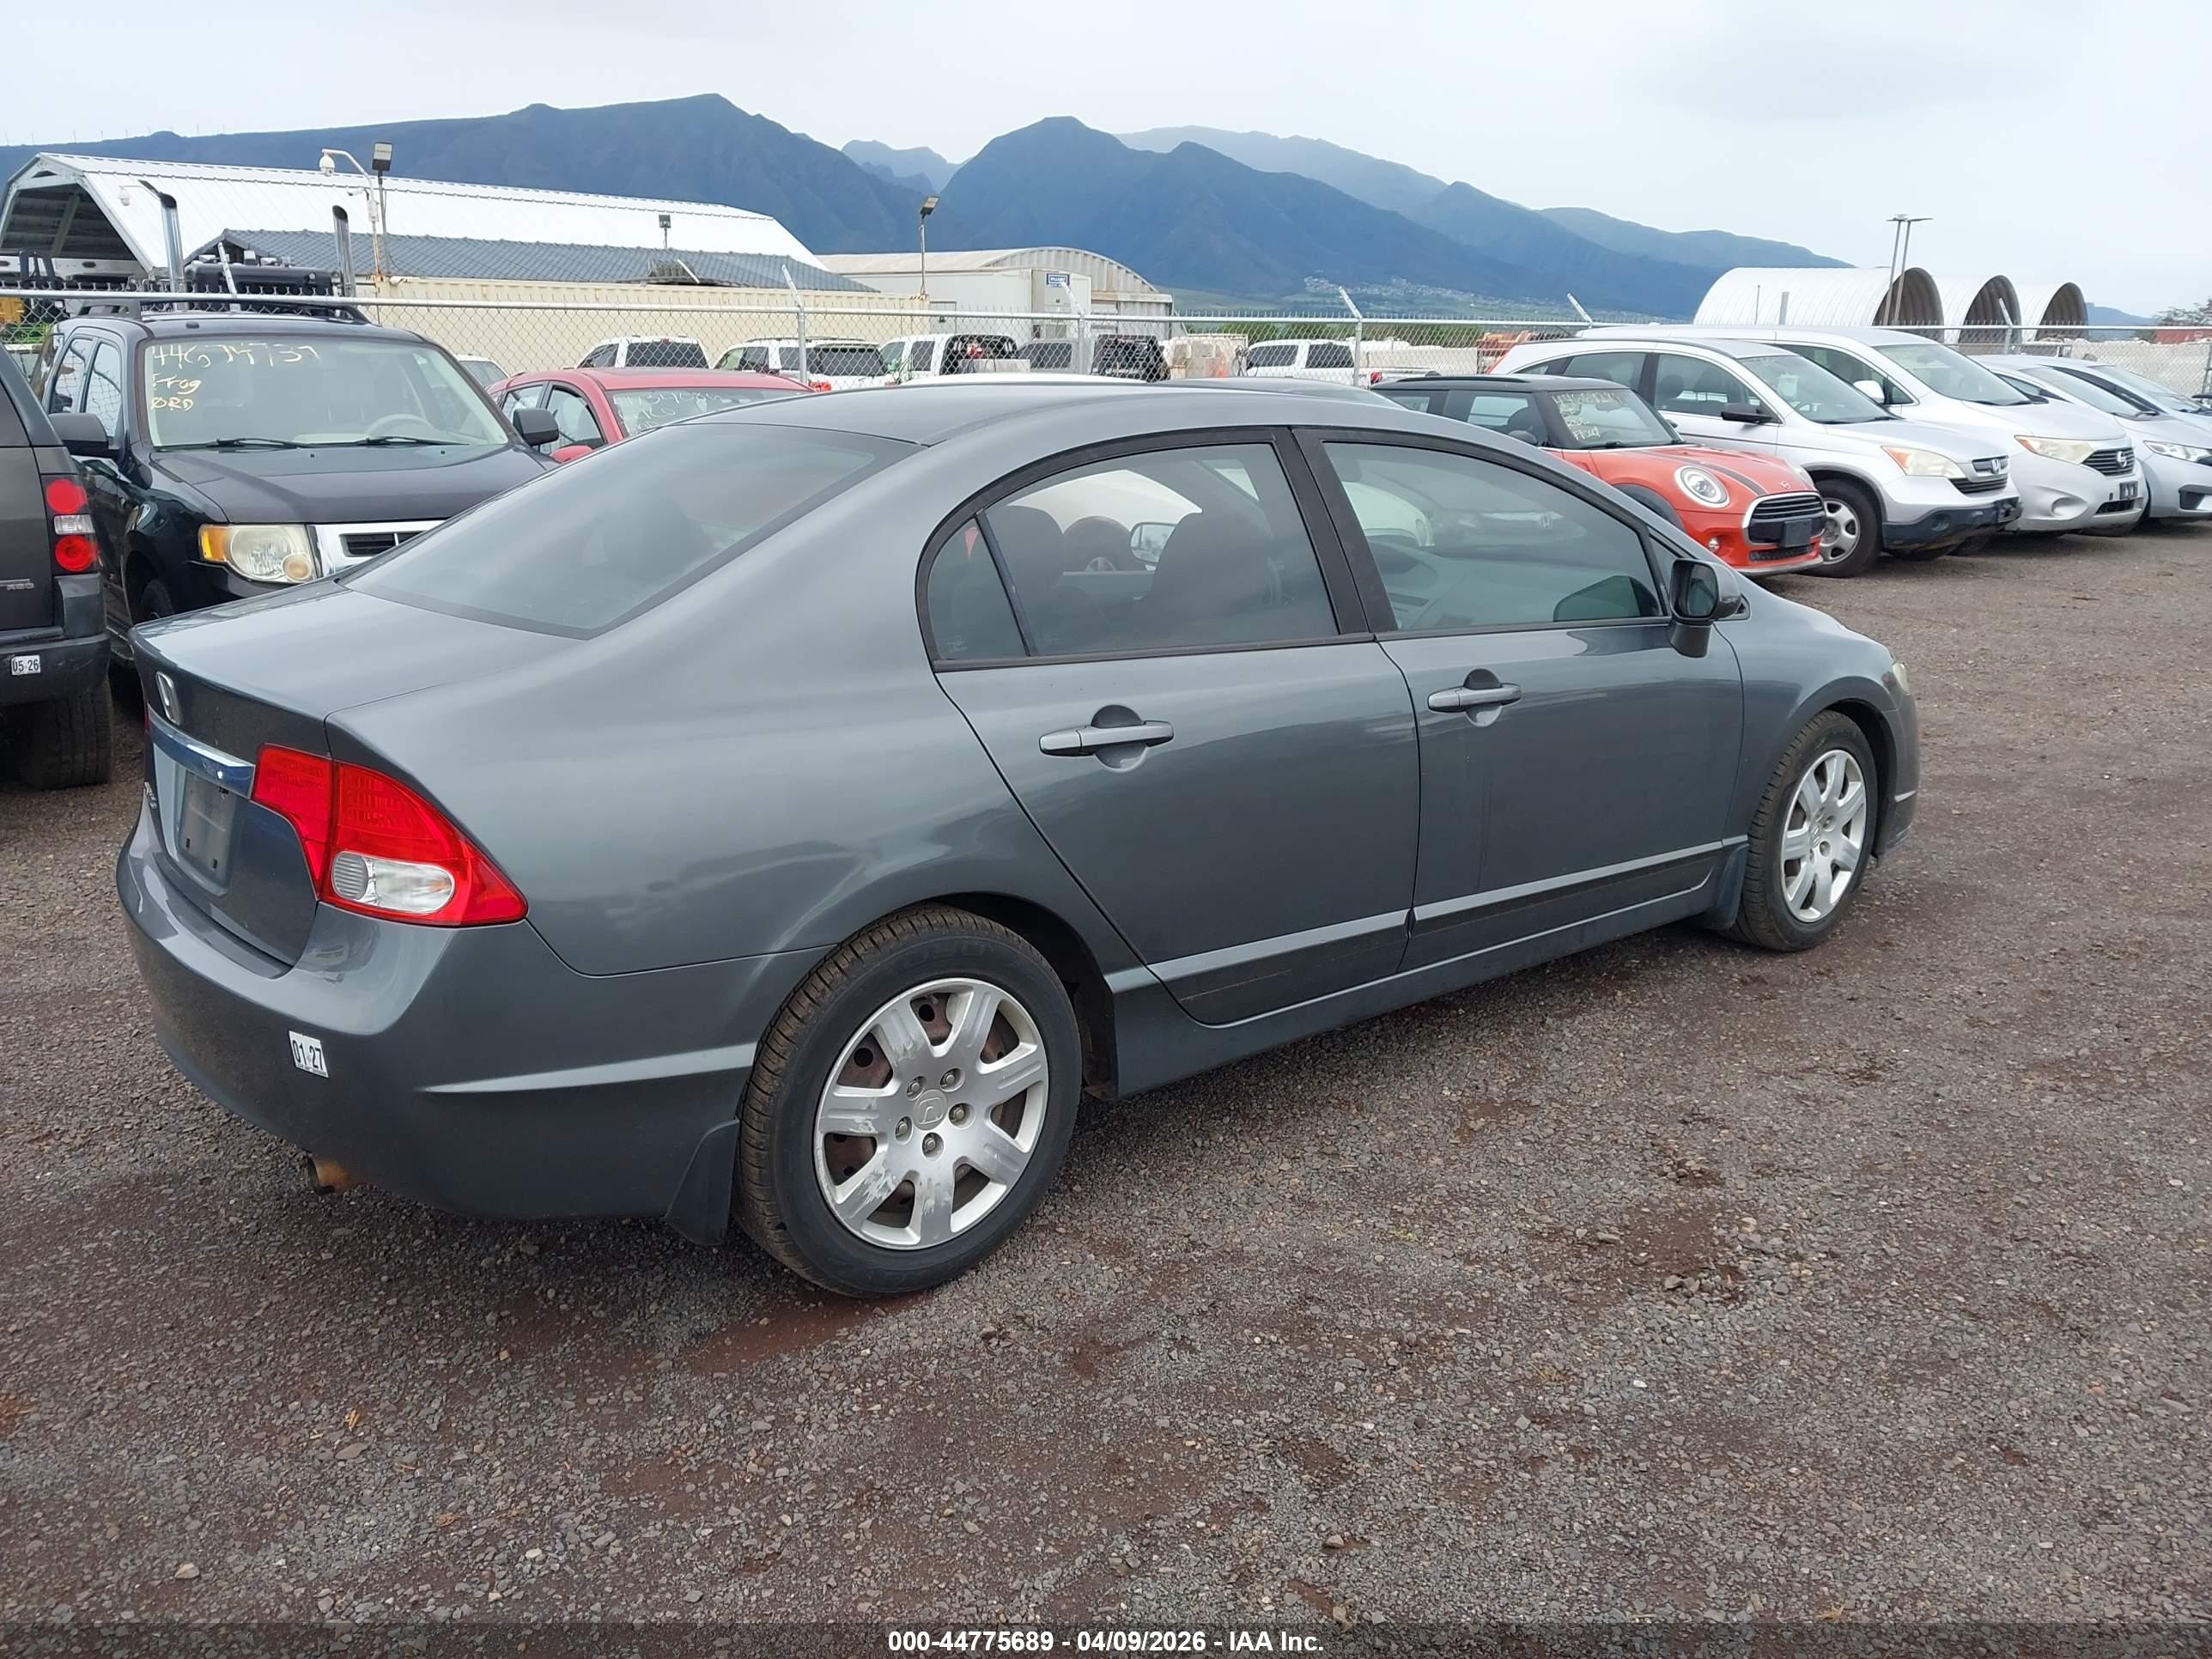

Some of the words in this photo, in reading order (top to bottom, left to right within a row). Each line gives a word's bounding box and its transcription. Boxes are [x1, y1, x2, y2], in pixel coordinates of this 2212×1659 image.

[12, 660, 24, 672] 05
[27, 659, 40, 672] 26
[292, 1039, 307, 1066] 01
[309, 1044, 324, 1071] 27
